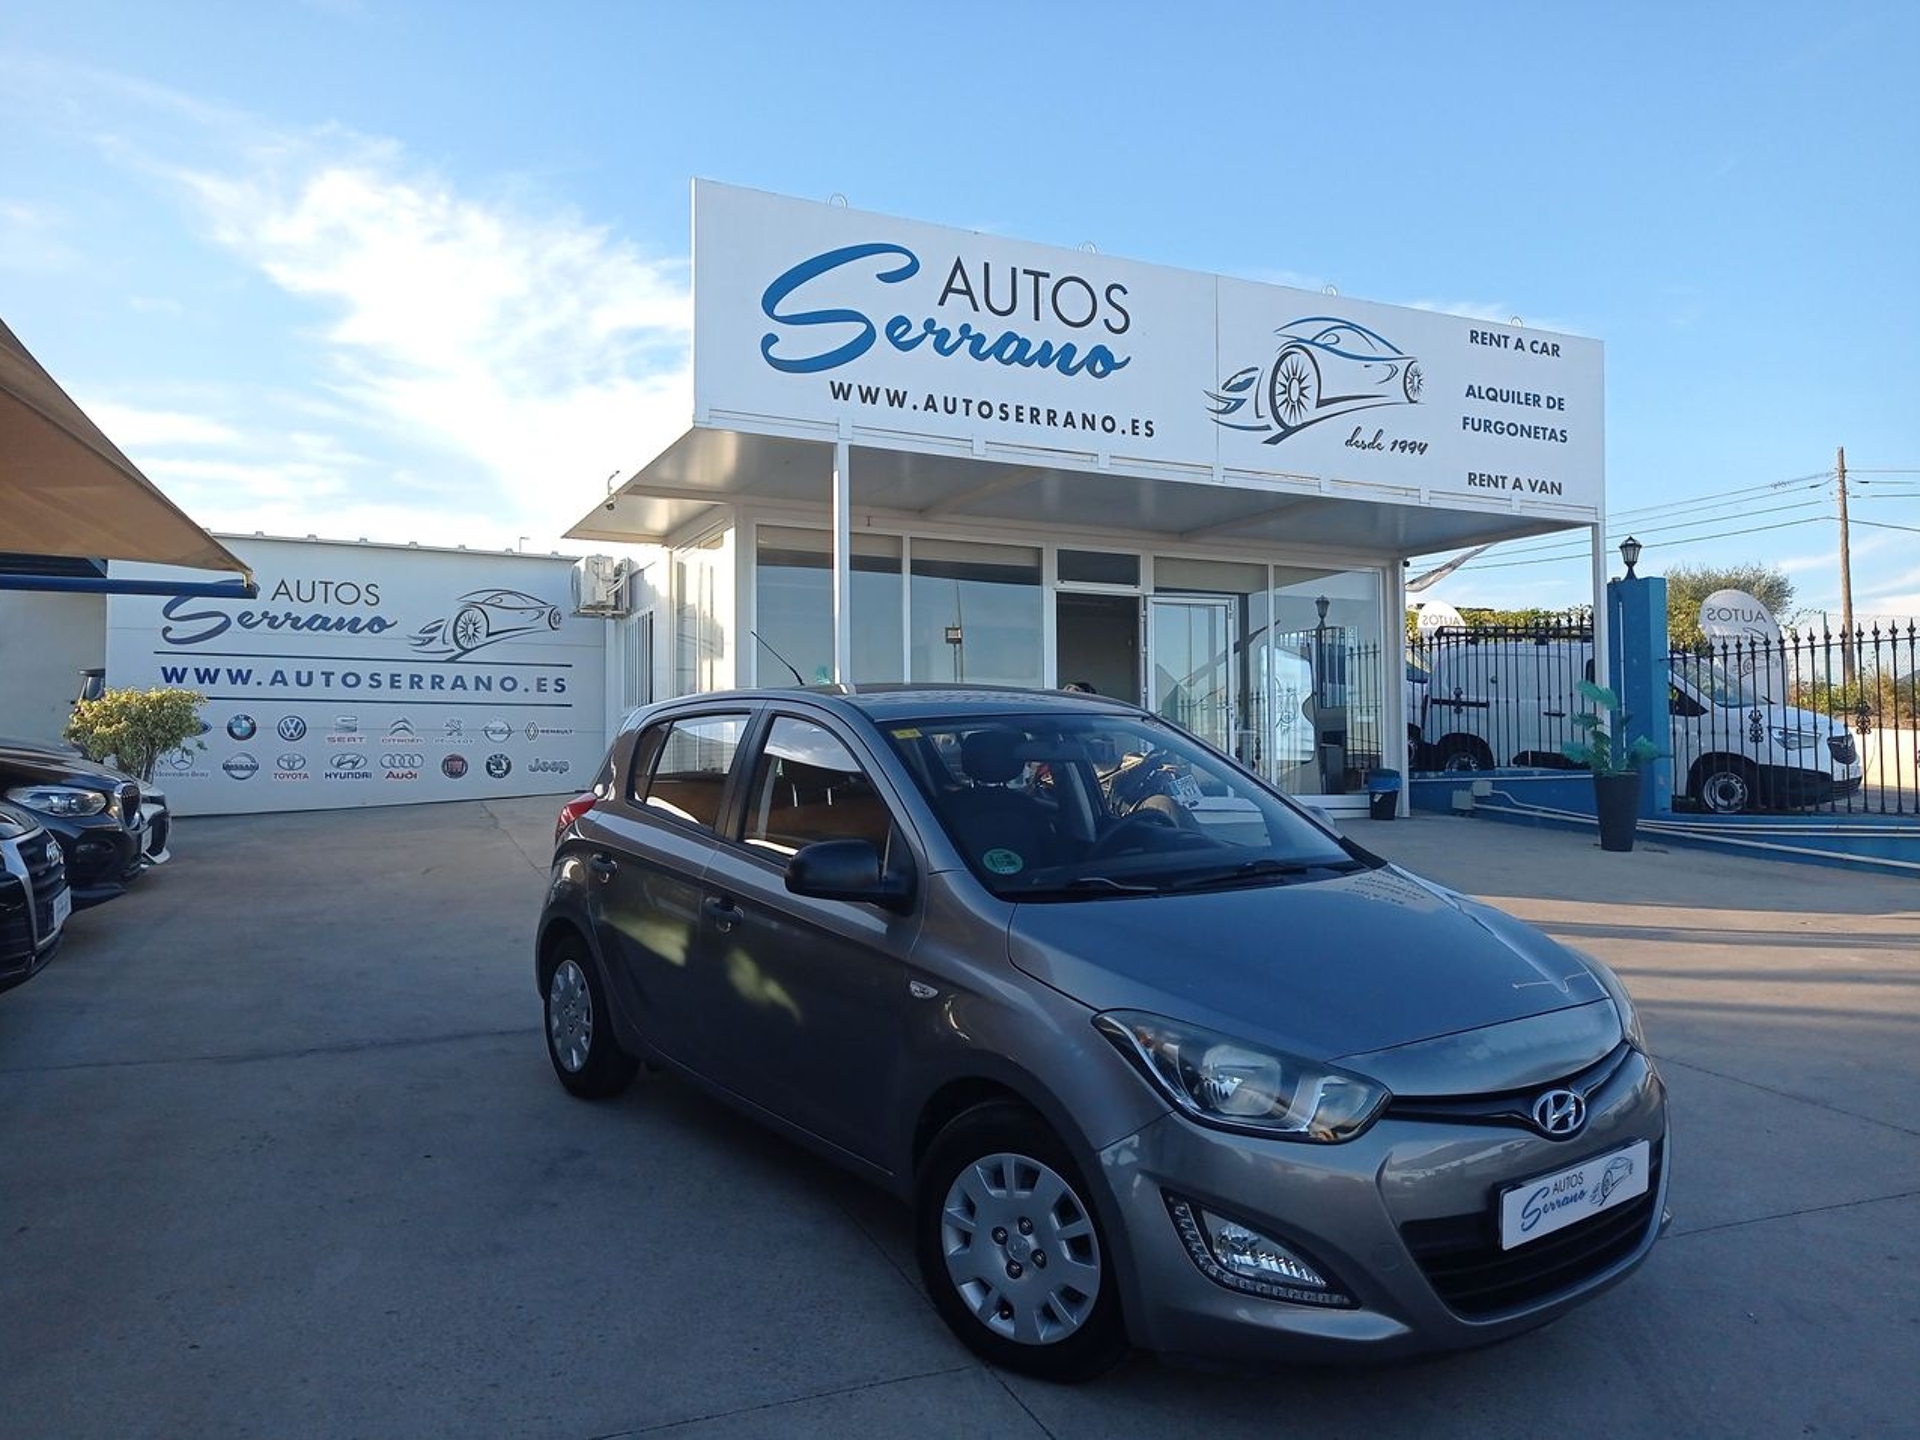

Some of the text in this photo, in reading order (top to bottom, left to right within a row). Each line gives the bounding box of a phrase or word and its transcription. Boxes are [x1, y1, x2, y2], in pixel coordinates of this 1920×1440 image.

[938, 256, 1131, 335] AUTOS
[761, 243, 1131, 379] Serrano
[1469, 329, 1561, 357] RENT A CAR
[830, 380, 1155, 438] WWW.AUTOSERRANO.ES
[1465, 385, 1565, 411] ALQUILER DE
[1345, 426, 1429, 455] desde 1994
[1462, 416, 1568, 443] FURGONETAS
[1467, 472, 1563, 496] RENT A VAN
[271, 579, 380, 607] AUTOS
[162, 579, 397, 645] Serrano
[161, 665, 567, 694] WWW.AUTOSERRANO.ES
[325, 771, 372, 779] HYUNDAI
[385, 771, 418, 779] Audi
[528, 758, 570, 774] Jeep
[1552, 1172, 1584, 1193] AUTOS
[1521, 1187, 1587, 1232] Serrano
